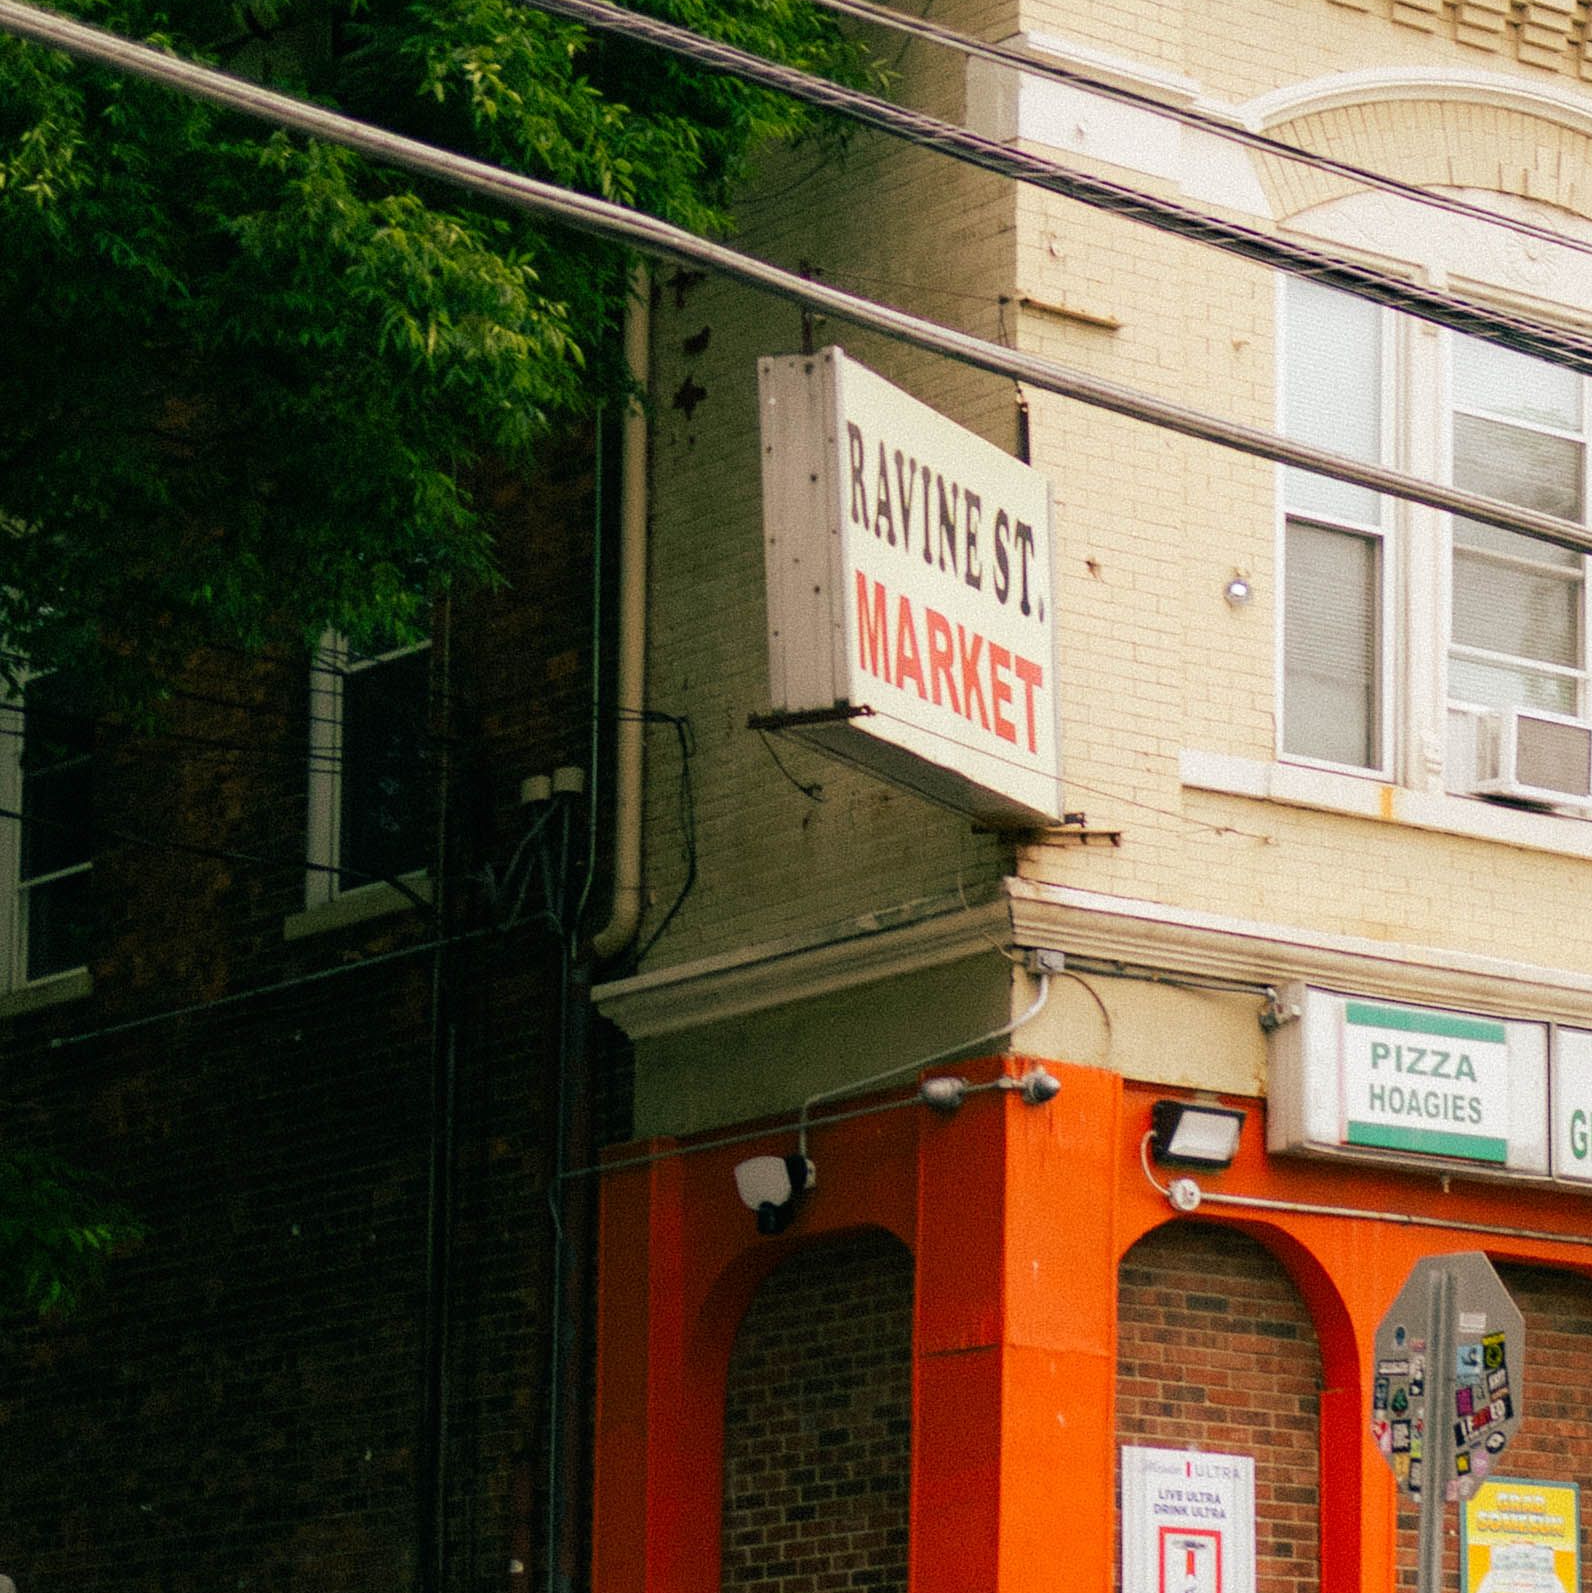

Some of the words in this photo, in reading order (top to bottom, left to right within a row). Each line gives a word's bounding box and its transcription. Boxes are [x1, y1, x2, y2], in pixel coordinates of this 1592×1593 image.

[847, 420, 983, 592] RAVINE
[992, 507, 1046, 624] ST.
[855, 568, 1044, 755] MARKET
[1370, 1041, 1477, 1083] PIZZA
[1368, 1082, 1483, 1125] HOAGIES
[1194, 1464, 1242, 1479] ULTRA
[1186, 1491, 1222, 1505] ULTRA
[1190, 1506, 1227, 1520] ULTRA
